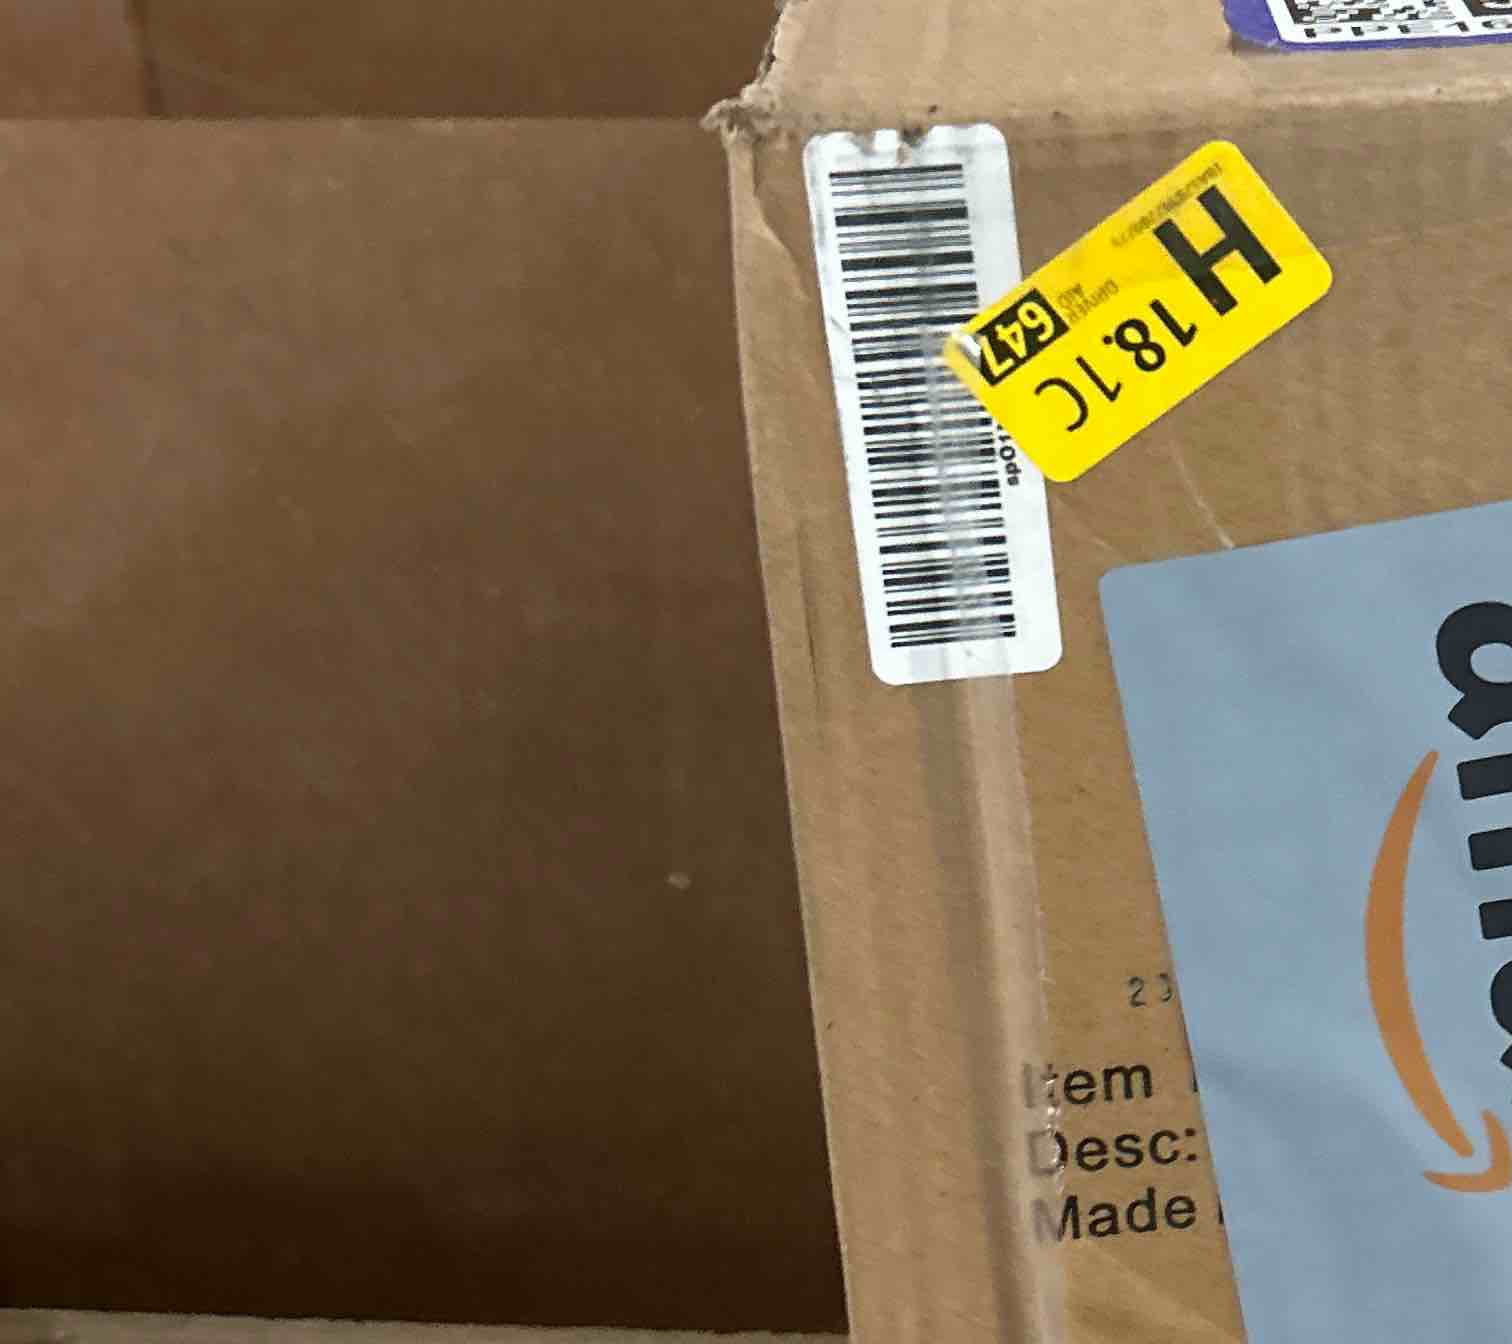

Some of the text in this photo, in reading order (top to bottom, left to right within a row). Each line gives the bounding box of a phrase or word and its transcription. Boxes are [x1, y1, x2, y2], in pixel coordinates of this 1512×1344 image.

[1154, 183, 1283, 317] H
[979, 300, 1056, 377] 647
[1022, 1062, 1153, 1107] Item
[1027, 1127, 1198, 1176] Desc:
[1031, 1186, 1198, 1245] Made
